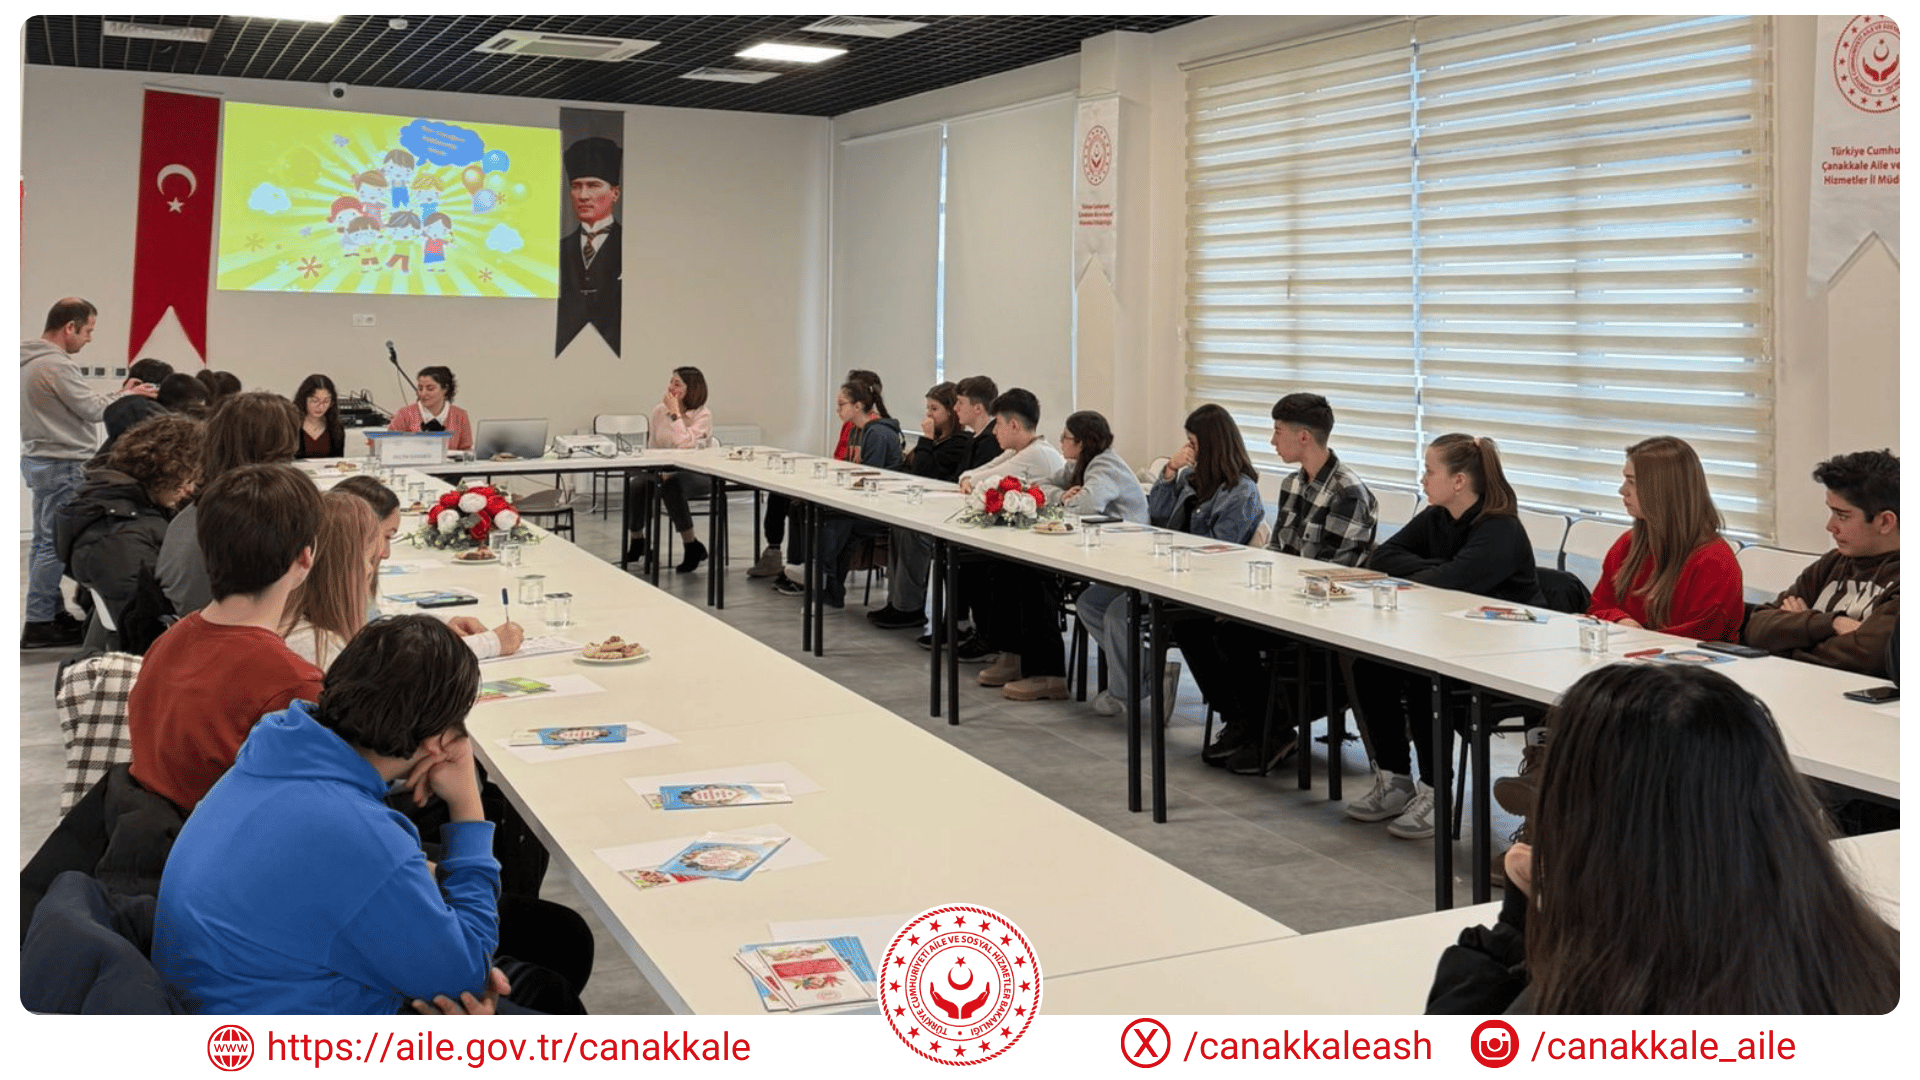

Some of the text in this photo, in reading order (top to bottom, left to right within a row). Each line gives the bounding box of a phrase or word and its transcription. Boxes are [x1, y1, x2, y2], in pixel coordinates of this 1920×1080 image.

[1831, 146, 1865, 158] Türkiye
[1822, 160, 1869, 172] Çanakkale
[1823, 174, 1868, 185] Hizmetler
